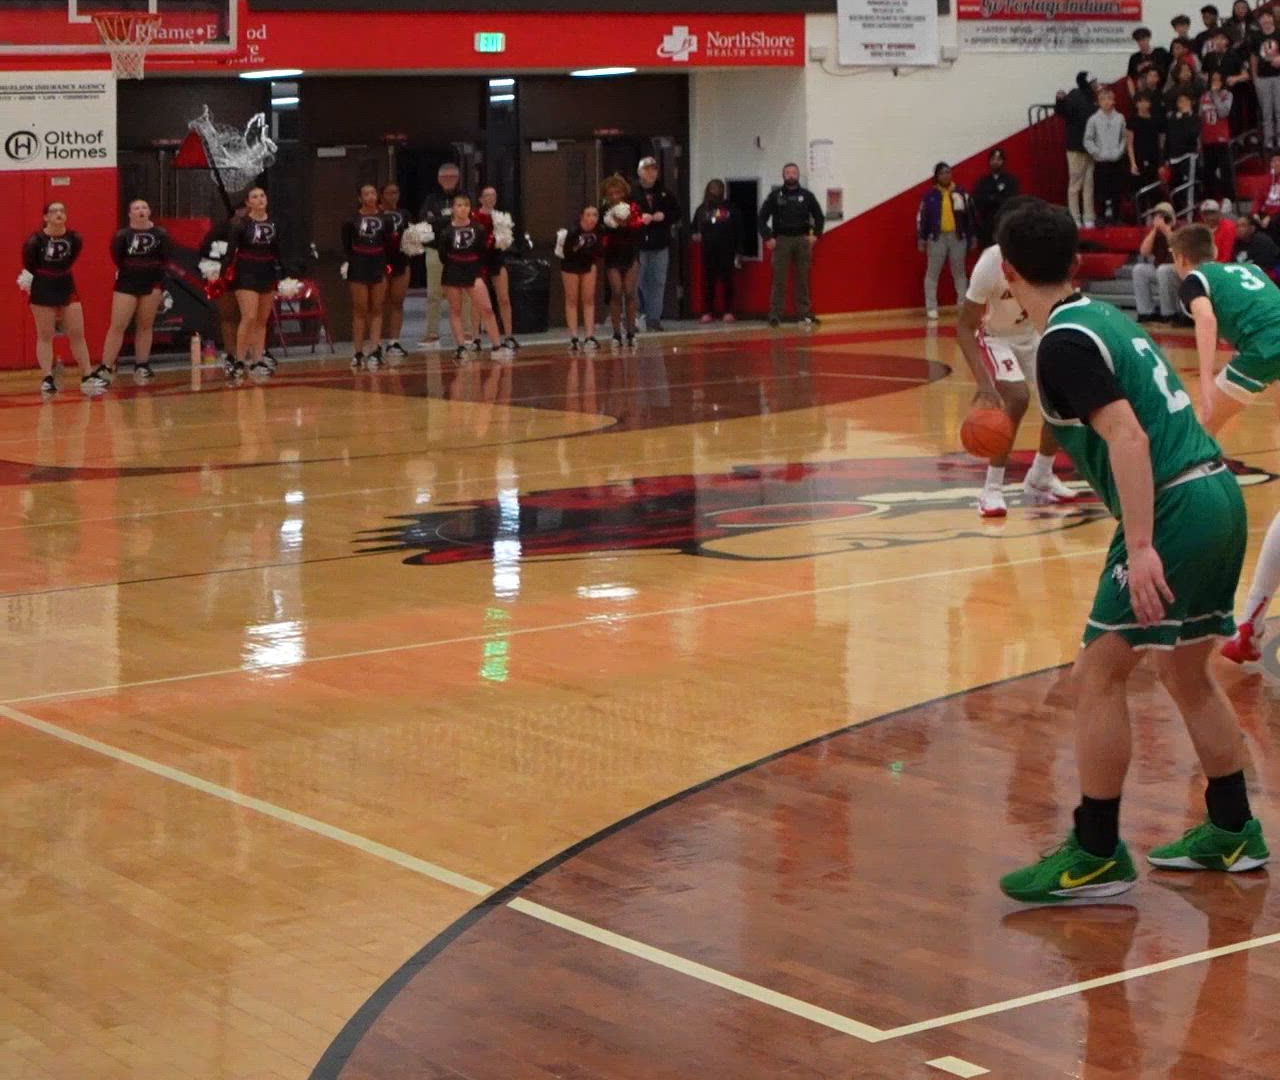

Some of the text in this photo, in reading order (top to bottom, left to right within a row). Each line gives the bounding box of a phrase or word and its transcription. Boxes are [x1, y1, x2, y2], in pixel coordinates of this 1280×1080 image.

[706, 31, 795, 48] NorthShore
[706, 49, 795, 58] HEALTH CENTERS
[44, 129, 103, 146] Olthof
[45, 145, 108, 161] Homes
